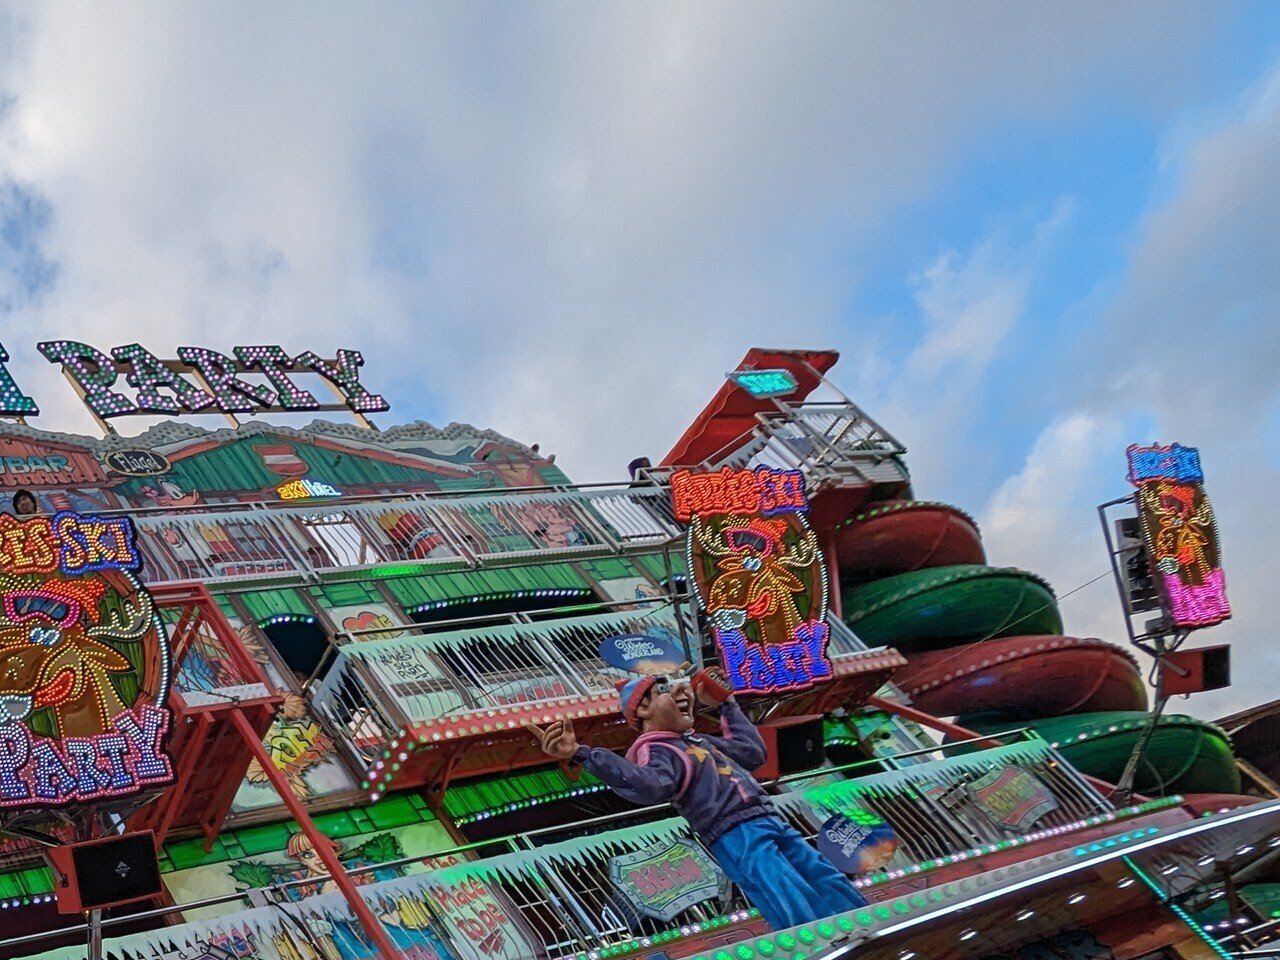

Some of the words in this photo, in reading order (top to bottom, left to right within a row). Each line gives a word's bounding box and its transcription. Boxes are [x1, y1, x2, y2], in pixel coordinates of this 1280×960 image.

[37, 340, 390, 418] PARTY
[113, 450, 163, 474] Flügel
[721, 625, 830, 690] PARTY
